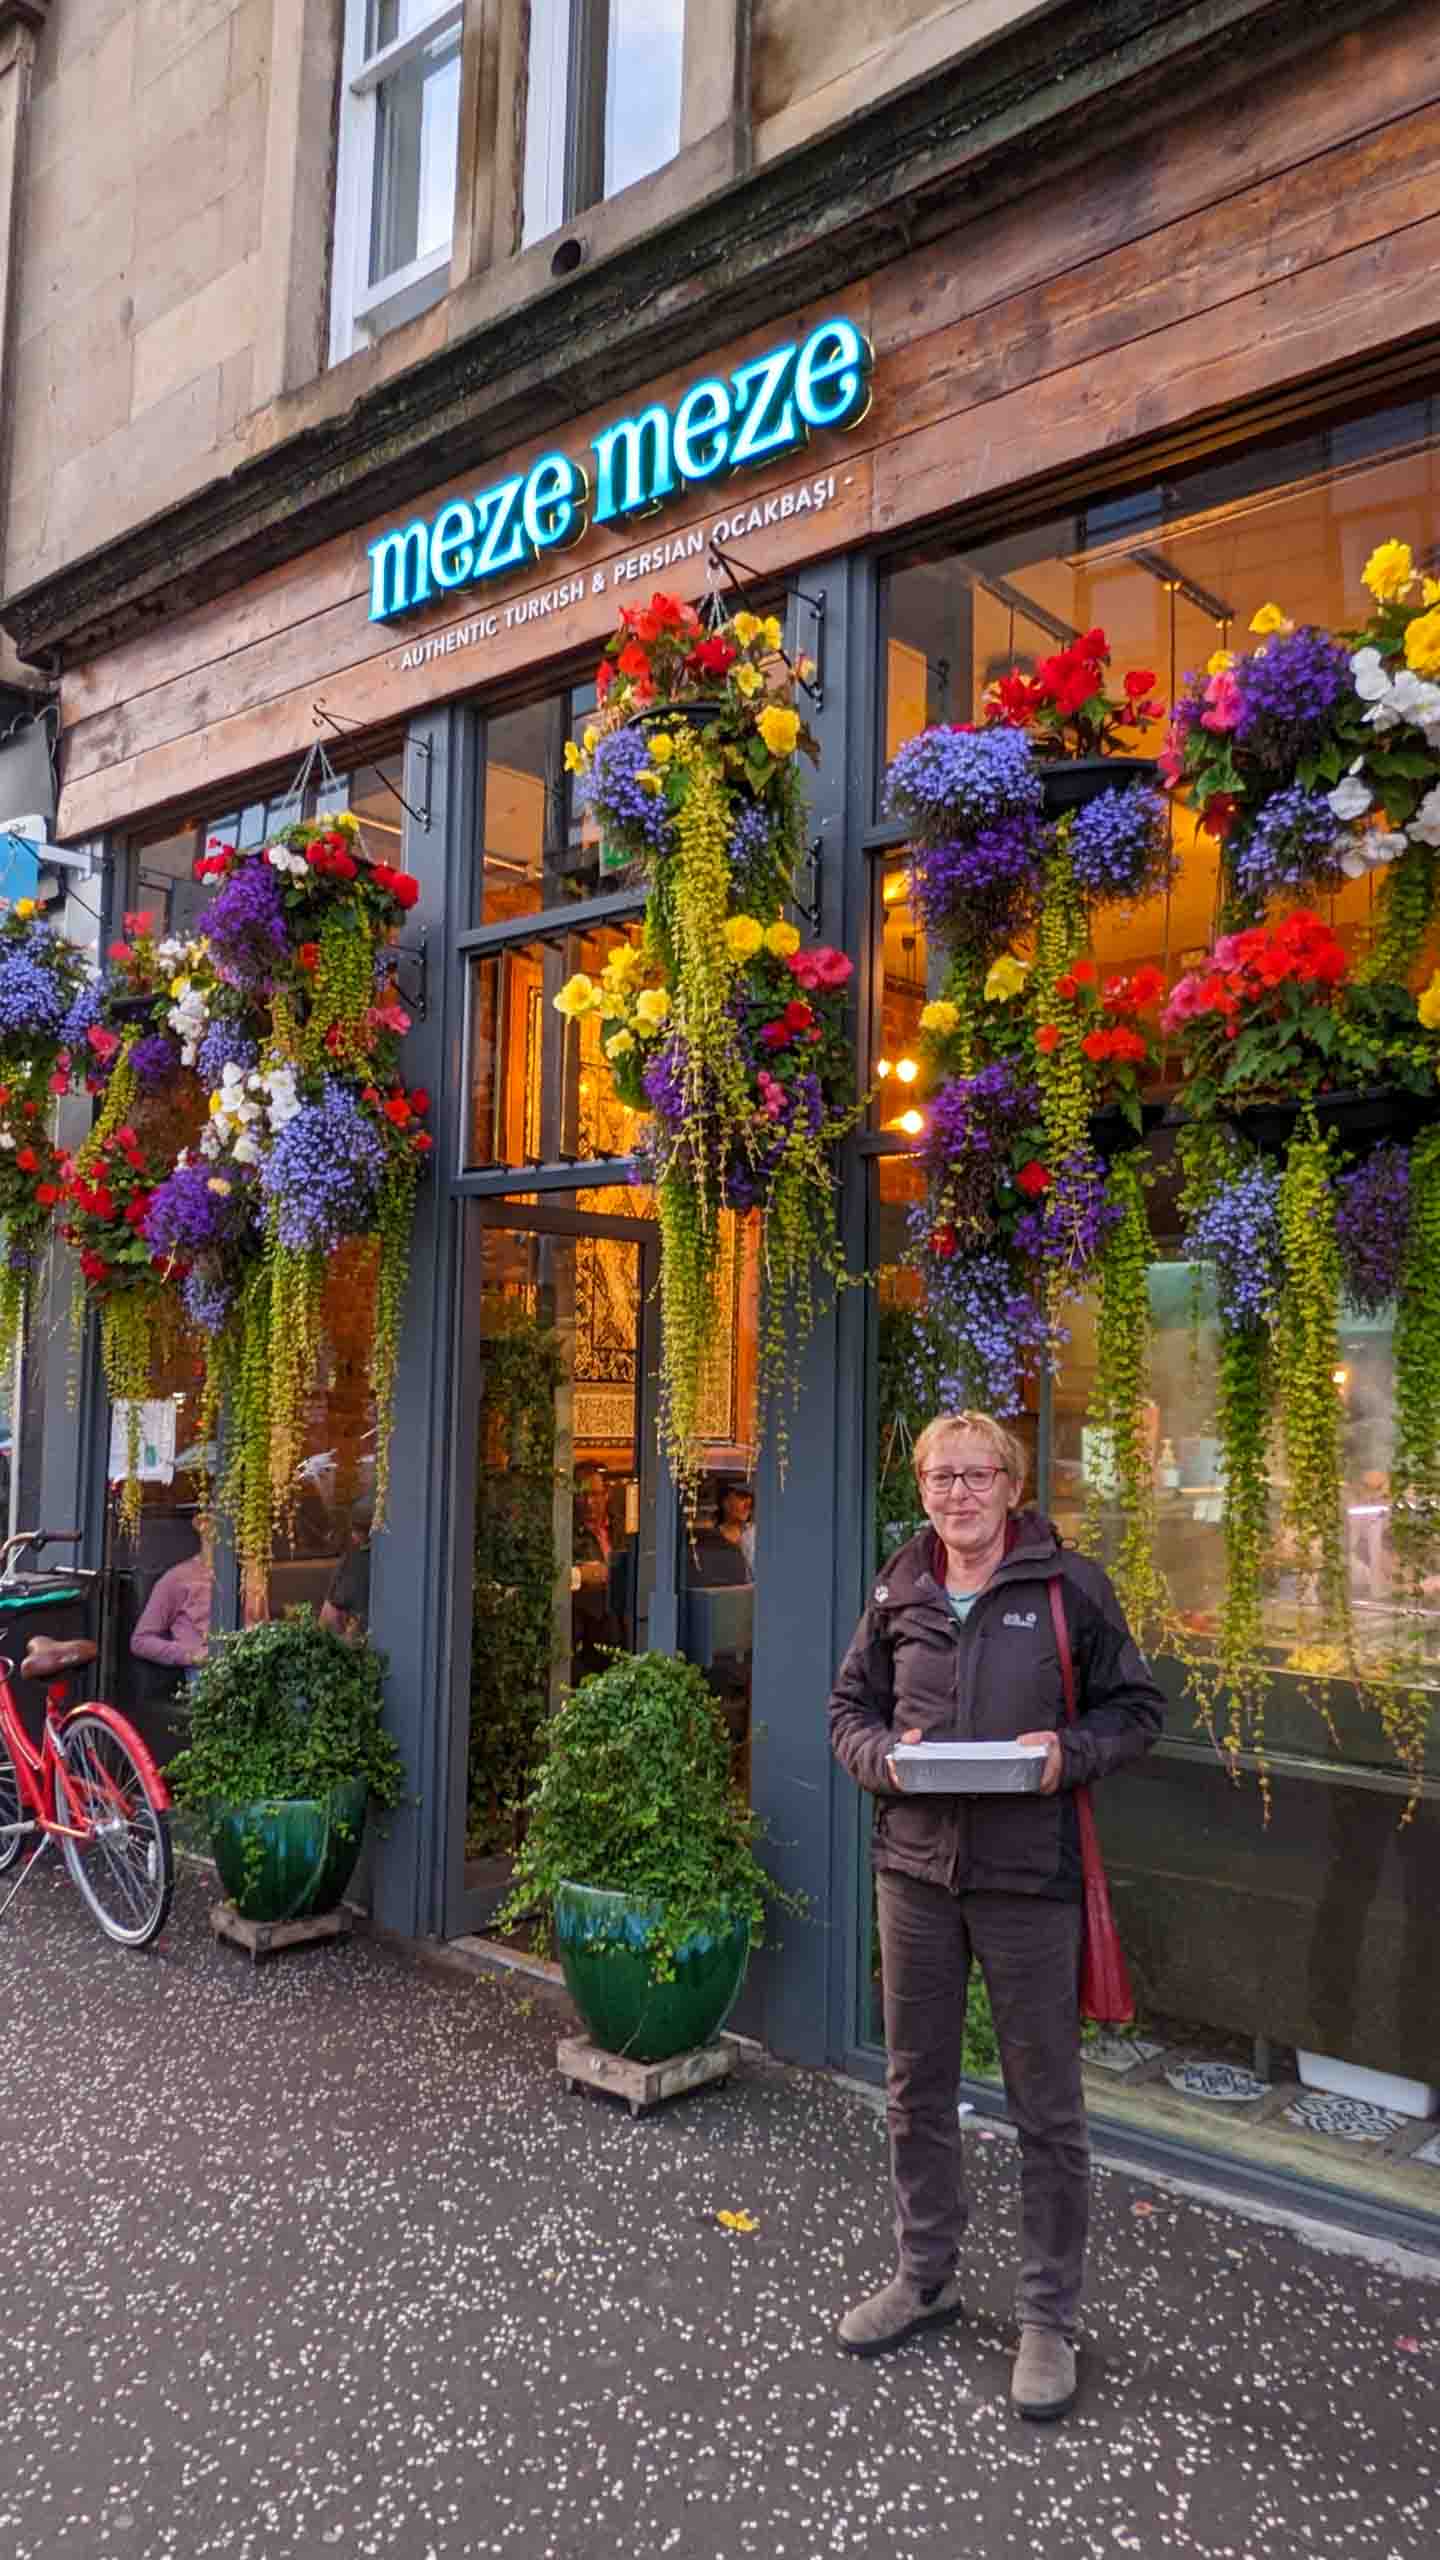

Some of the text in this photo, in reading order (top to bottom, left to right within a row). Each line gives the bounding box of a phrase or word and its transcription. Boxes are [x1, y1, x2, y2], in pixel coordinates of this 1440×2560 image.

[367, 316, 868, 622] meze meze
[401, 476, 835, 671] AUTHENTIC TURKISH & PERSIAN OCAKBAŞI
